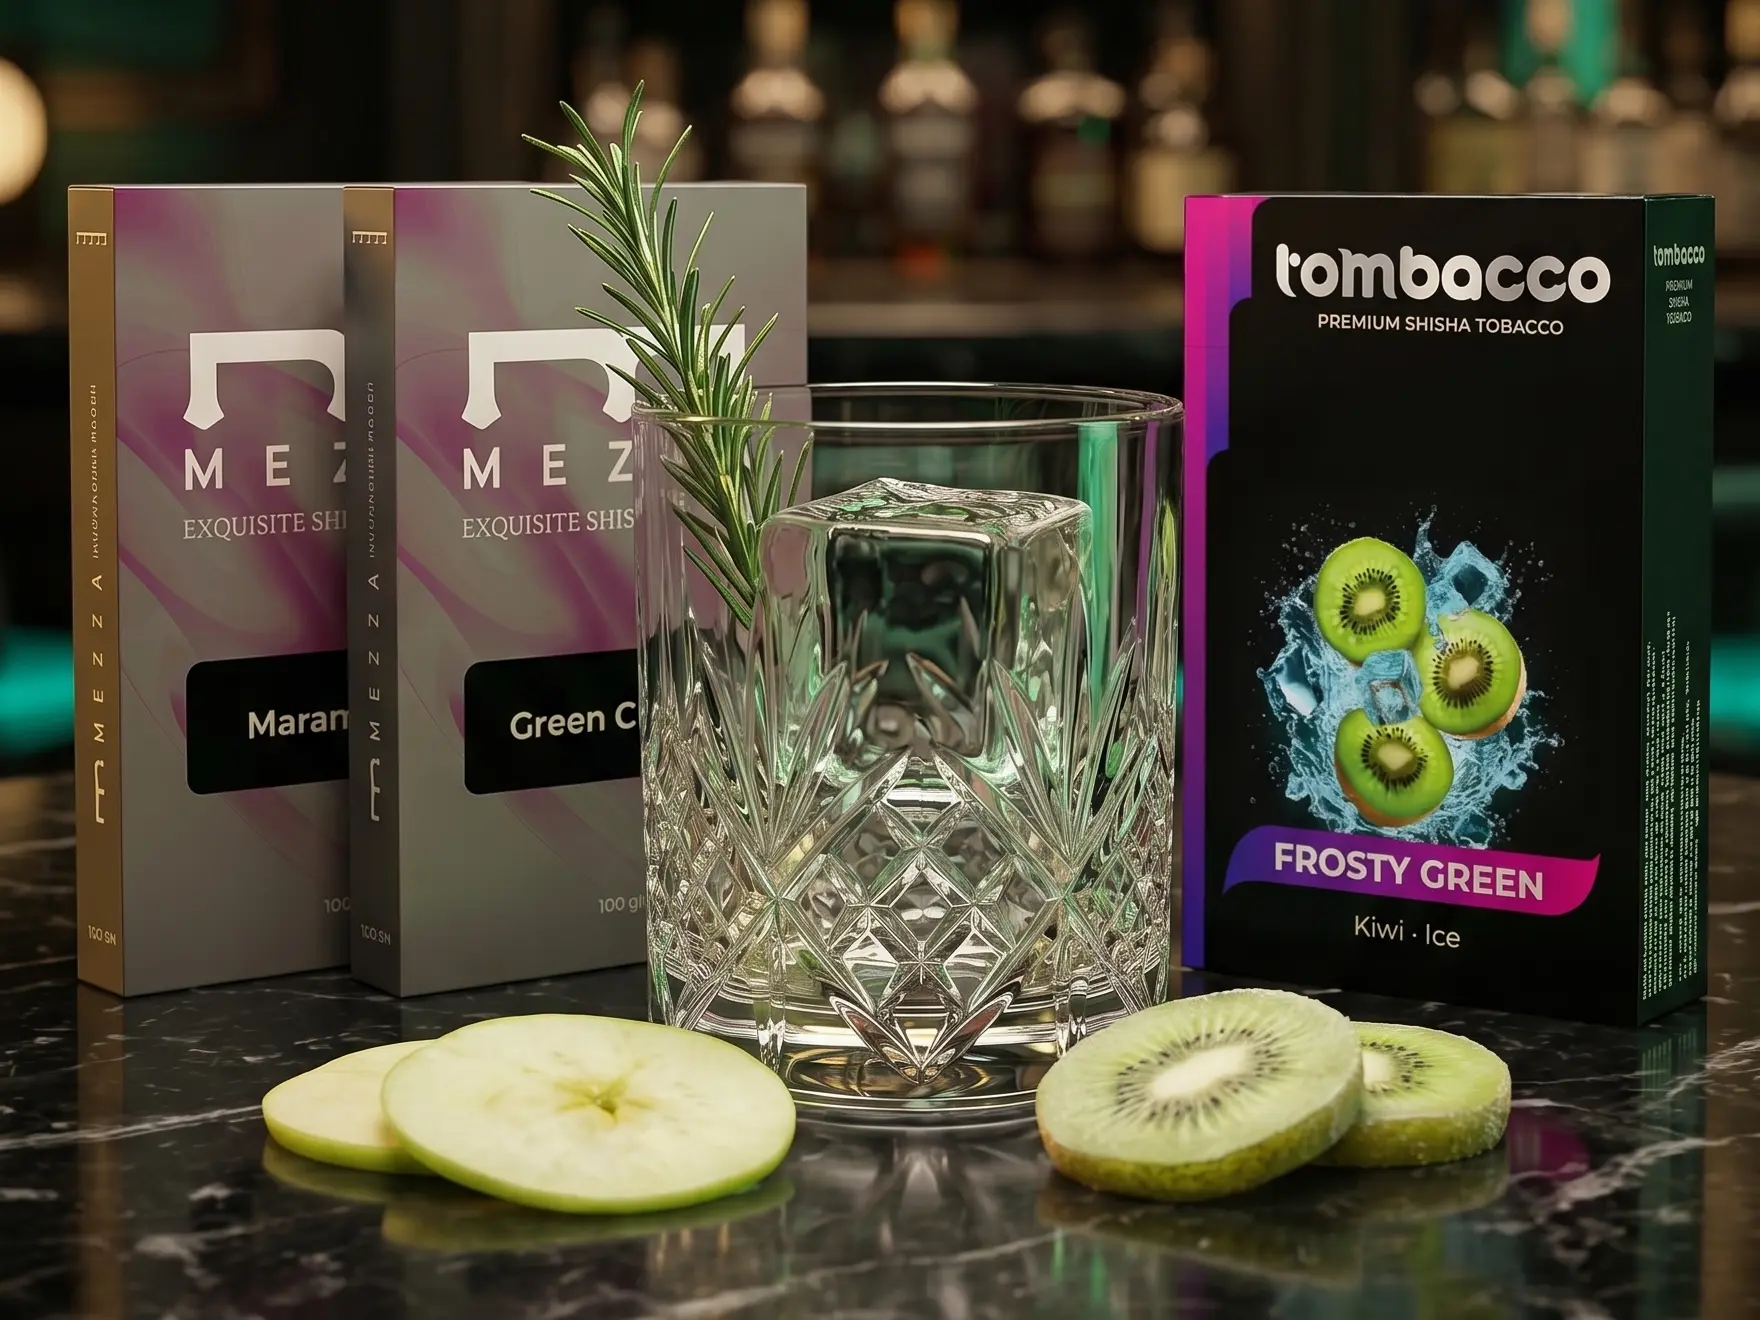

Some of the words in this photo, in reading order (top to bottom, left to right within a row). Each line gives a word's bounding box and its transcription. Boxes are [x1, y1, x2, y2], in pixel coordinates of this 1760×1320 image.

[1653, 243, 1705, 267] tombacco
[1276, 243, 1611, 304] tombacco
[1318, 314, 1400, 330] PREMIUM
[1405, 316, 1471, 333] SHISHA
[1475, 318, 1564, 335] TOBACCO
[183, 513, 306, 541] EXQUISITE
[462, 512, 581, 540] EXQUISITE
[586, 508, 635, 531] SHIS
[510, 711, 605, 740] Green
[615, 701, 637, 729] C
[1275, 842, 1411, 884] FROSTY
[1420, 859, 1543, 900] GREEN
[599, 896, 625, 914] 100
[1355, 915, 1403, 941] Kiwi
[1426, 924, 1460, 948] Ice
